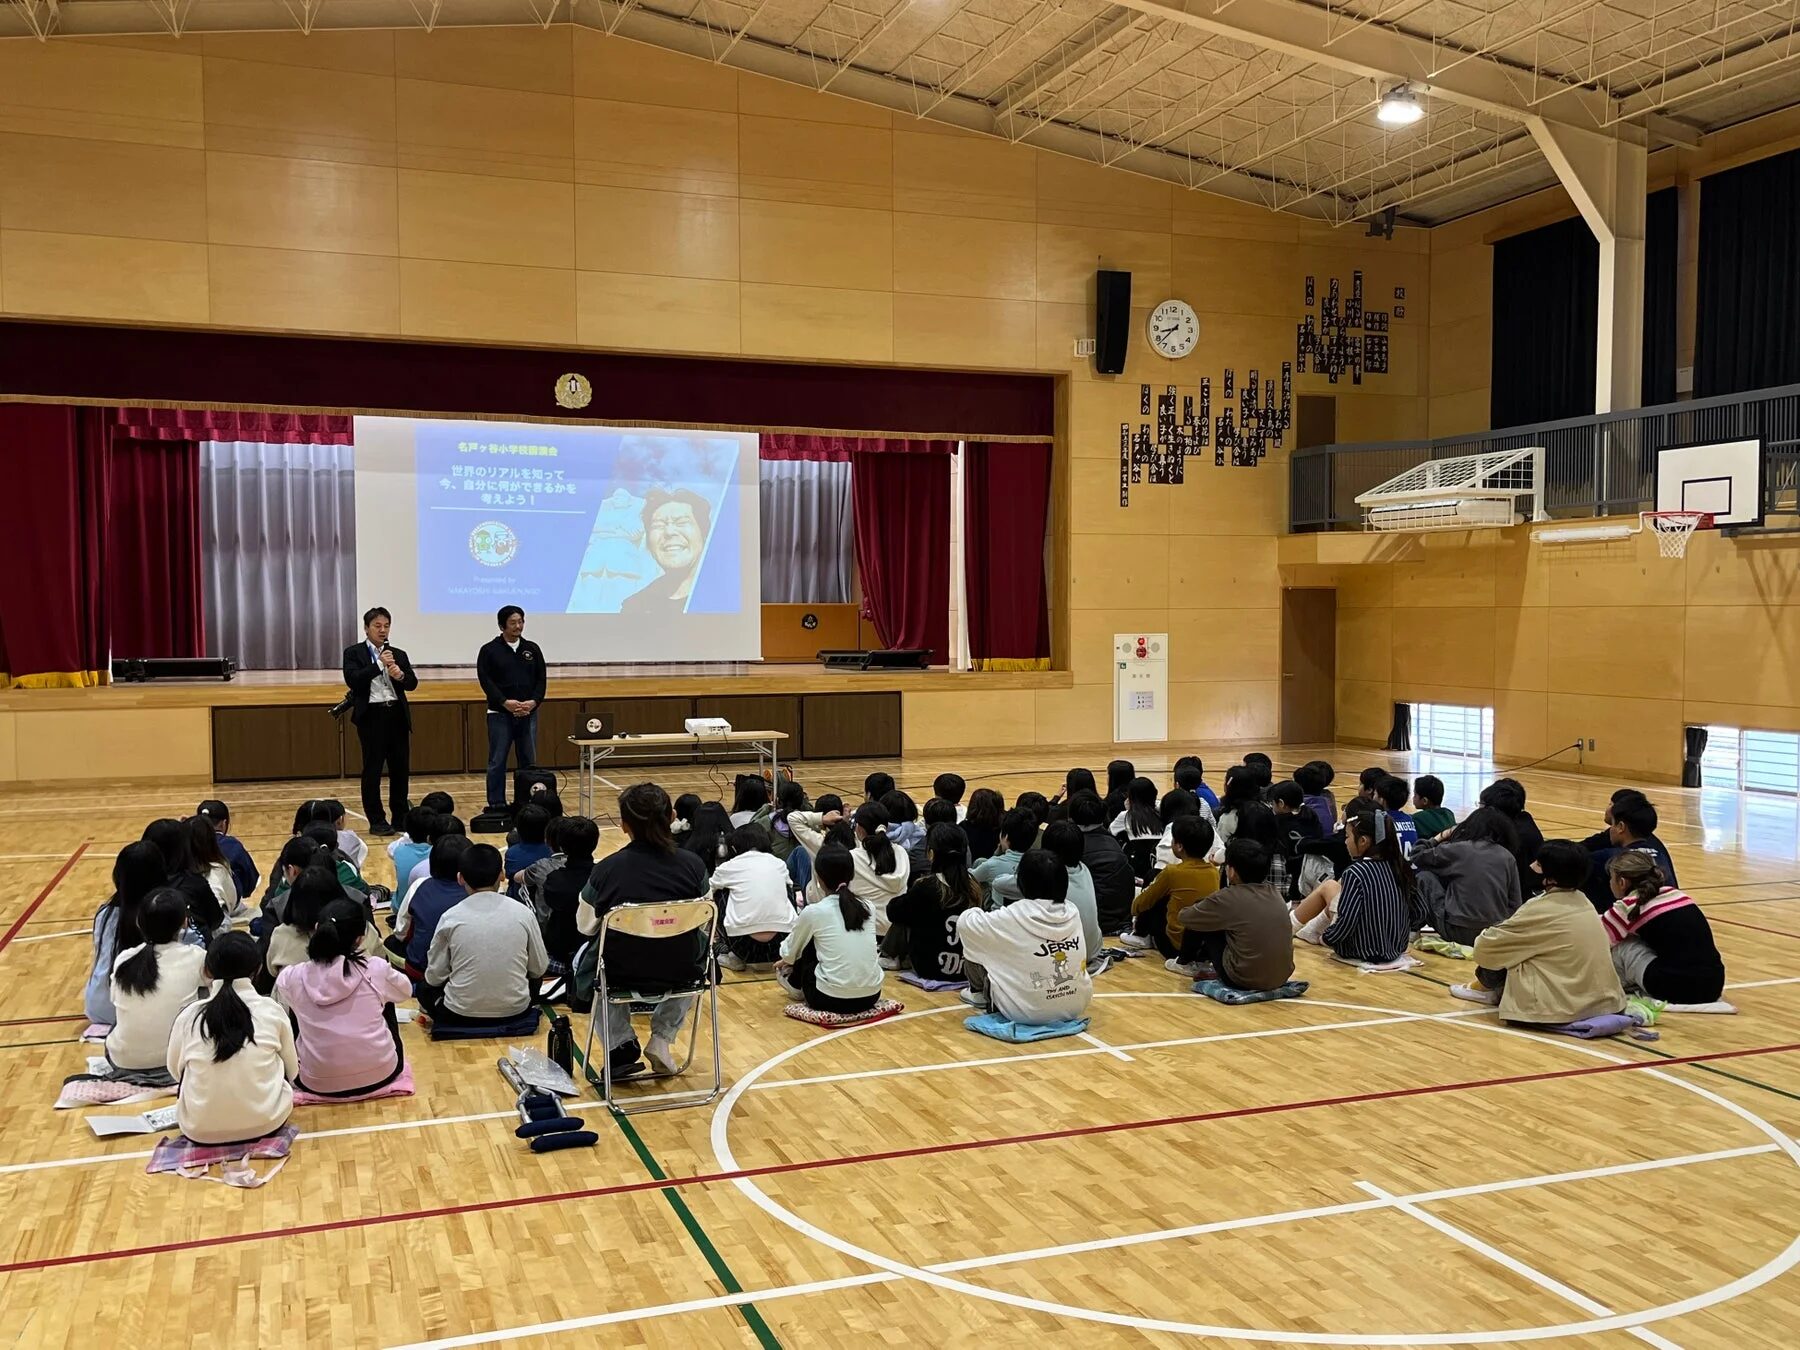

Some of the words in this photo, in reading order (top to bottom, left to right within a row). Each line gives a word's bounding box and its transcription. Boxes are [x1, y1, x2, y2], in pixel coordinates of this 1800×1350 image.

[1159, 404, 1167, 443] 良い子が
[1224, 409, 1232, 446] わたしの
[1141, 426, 1150, 463] わたしの
[439, 477, 577, 495] 今、自分に何ができるかを
[451, 464, 565, 481] 世界のリアルを知って
[1033, 936, 1079, 957] JERRY
